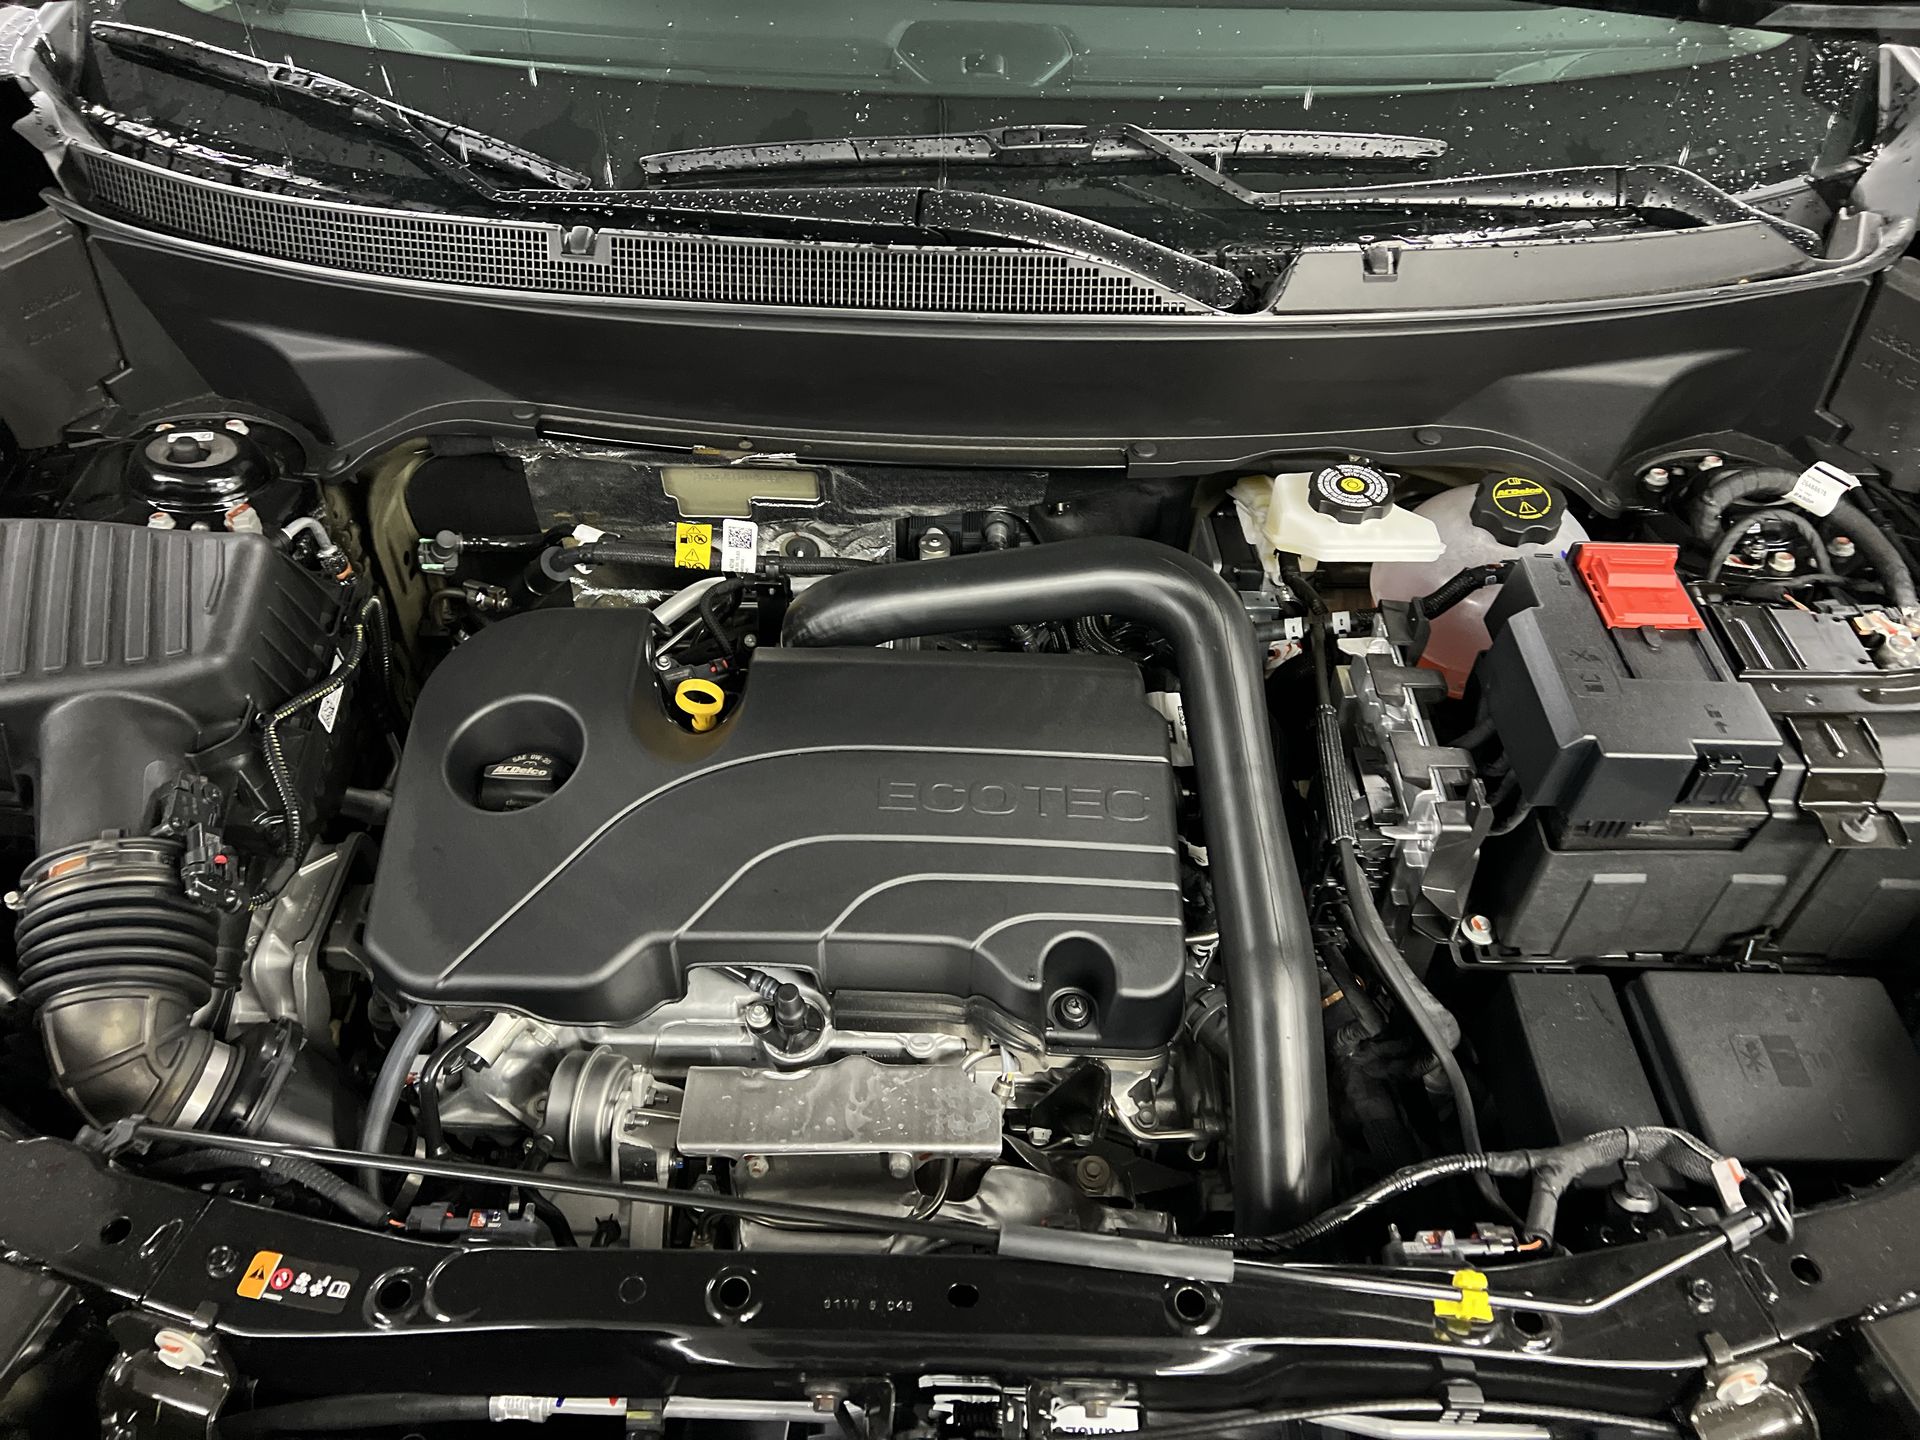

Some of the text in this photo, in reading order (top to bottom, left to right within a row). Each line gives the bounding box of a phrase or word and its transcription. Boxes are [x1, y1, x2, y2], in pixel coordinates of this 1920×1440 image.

[1496, 487, 1544, 499] ACDelco
[512, 754, 527, 763] SAE
[490, 765, 548, 777] ACDelco
[877, 776, 1151, 822] ECOTEC
